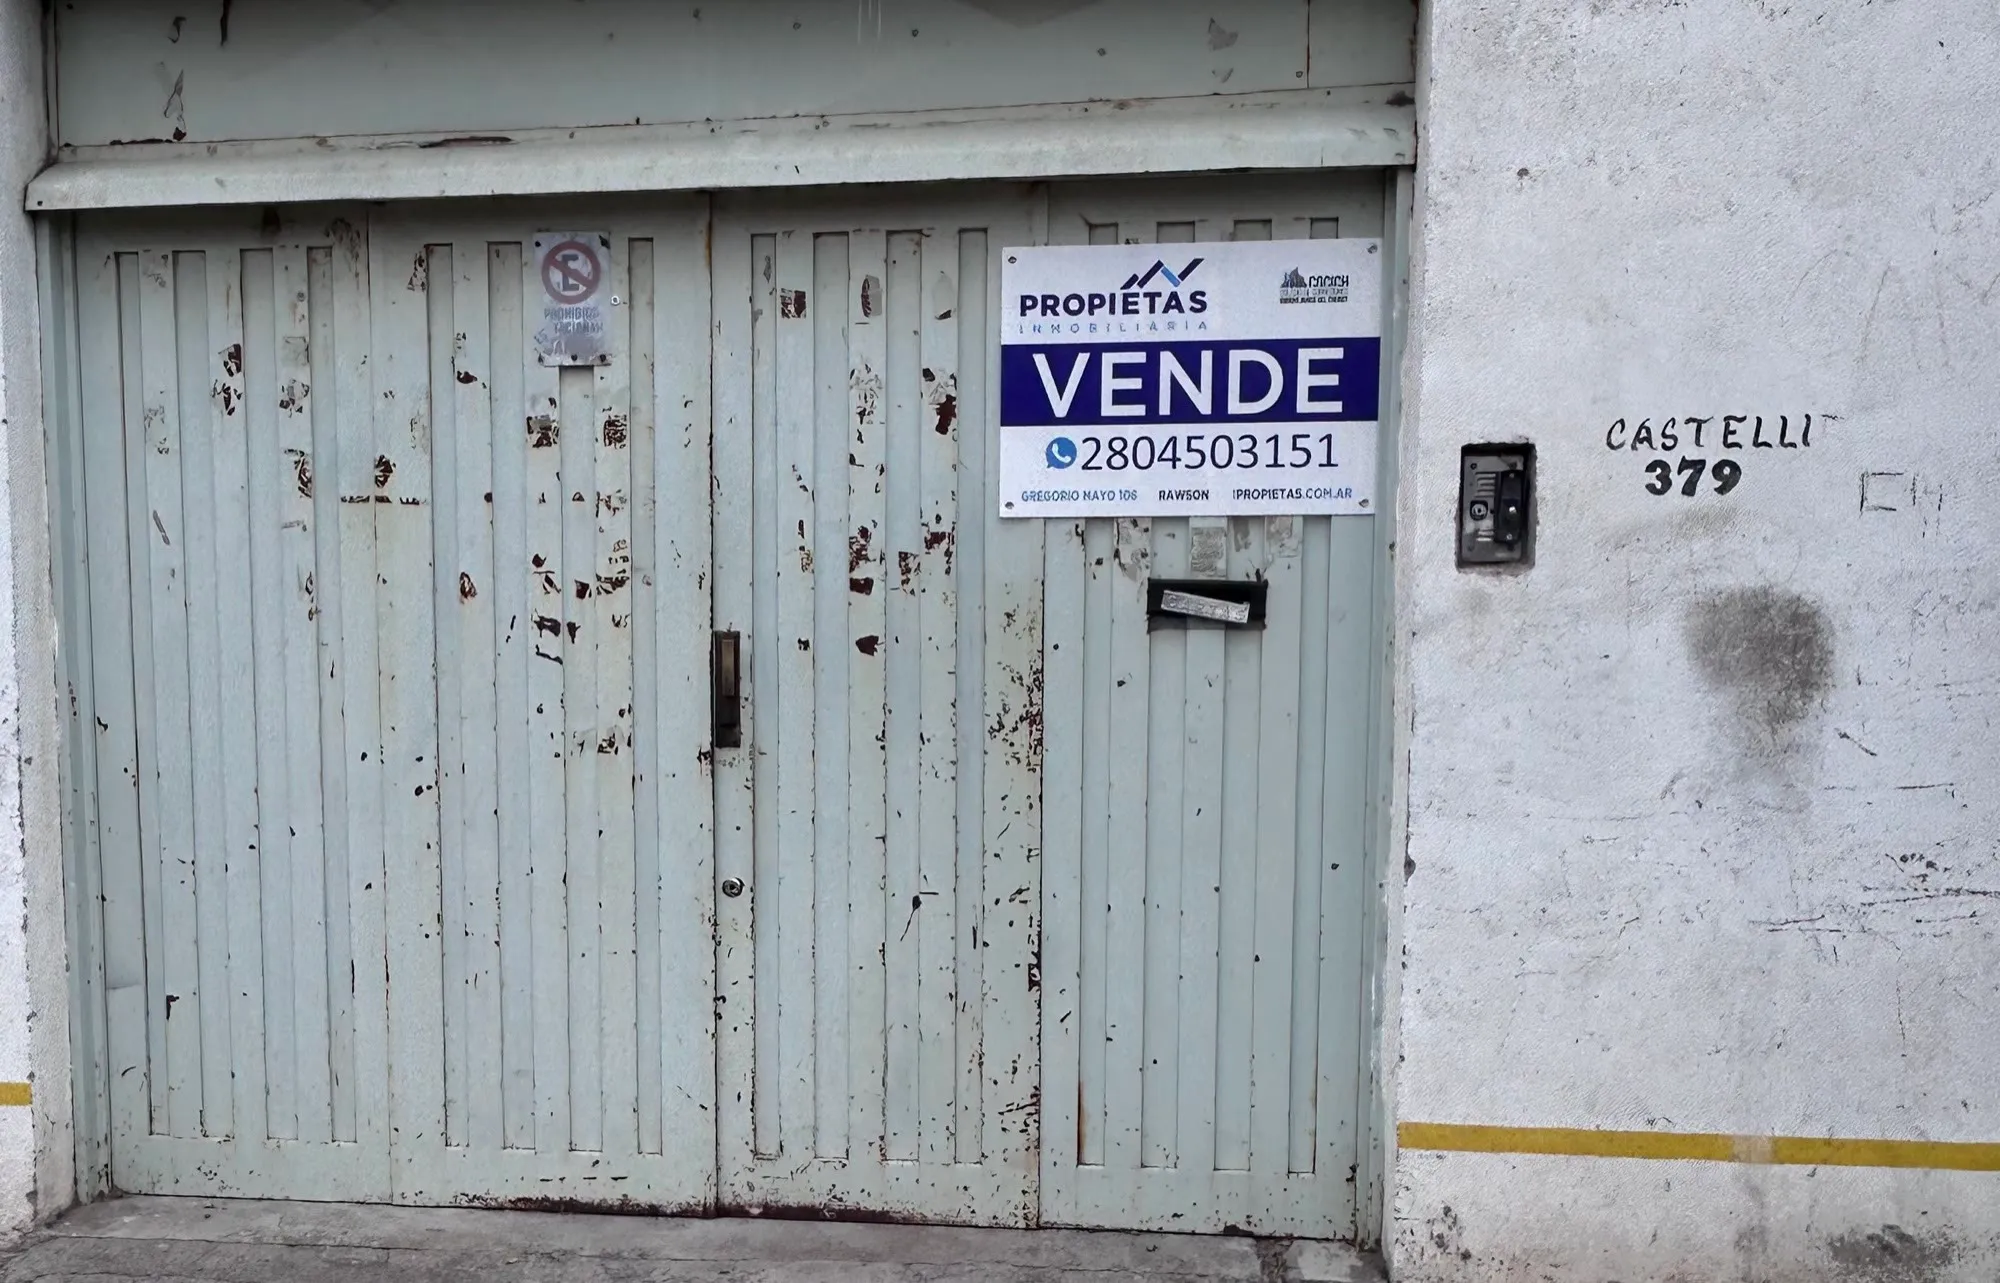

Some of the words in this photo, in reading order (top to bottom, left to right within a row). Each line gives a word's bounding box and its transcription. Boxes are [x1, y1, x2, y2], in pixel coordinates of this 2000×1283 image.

[1019, 290, 1208, 317] PROPIETAS
[1018, 321, 1208, 335] INMOBILIARIA
[1032, 347, 1345, 418] VENDE
[1606, 413, 1812, 451] CASTELLI
[1080, 433, 1339, 471] 2804503151
[1021, 489, 1080, 502] GREGORIO
[1158, 488, 1210, 501] RAWSON
[1644, 456, 1742, 497] 379
